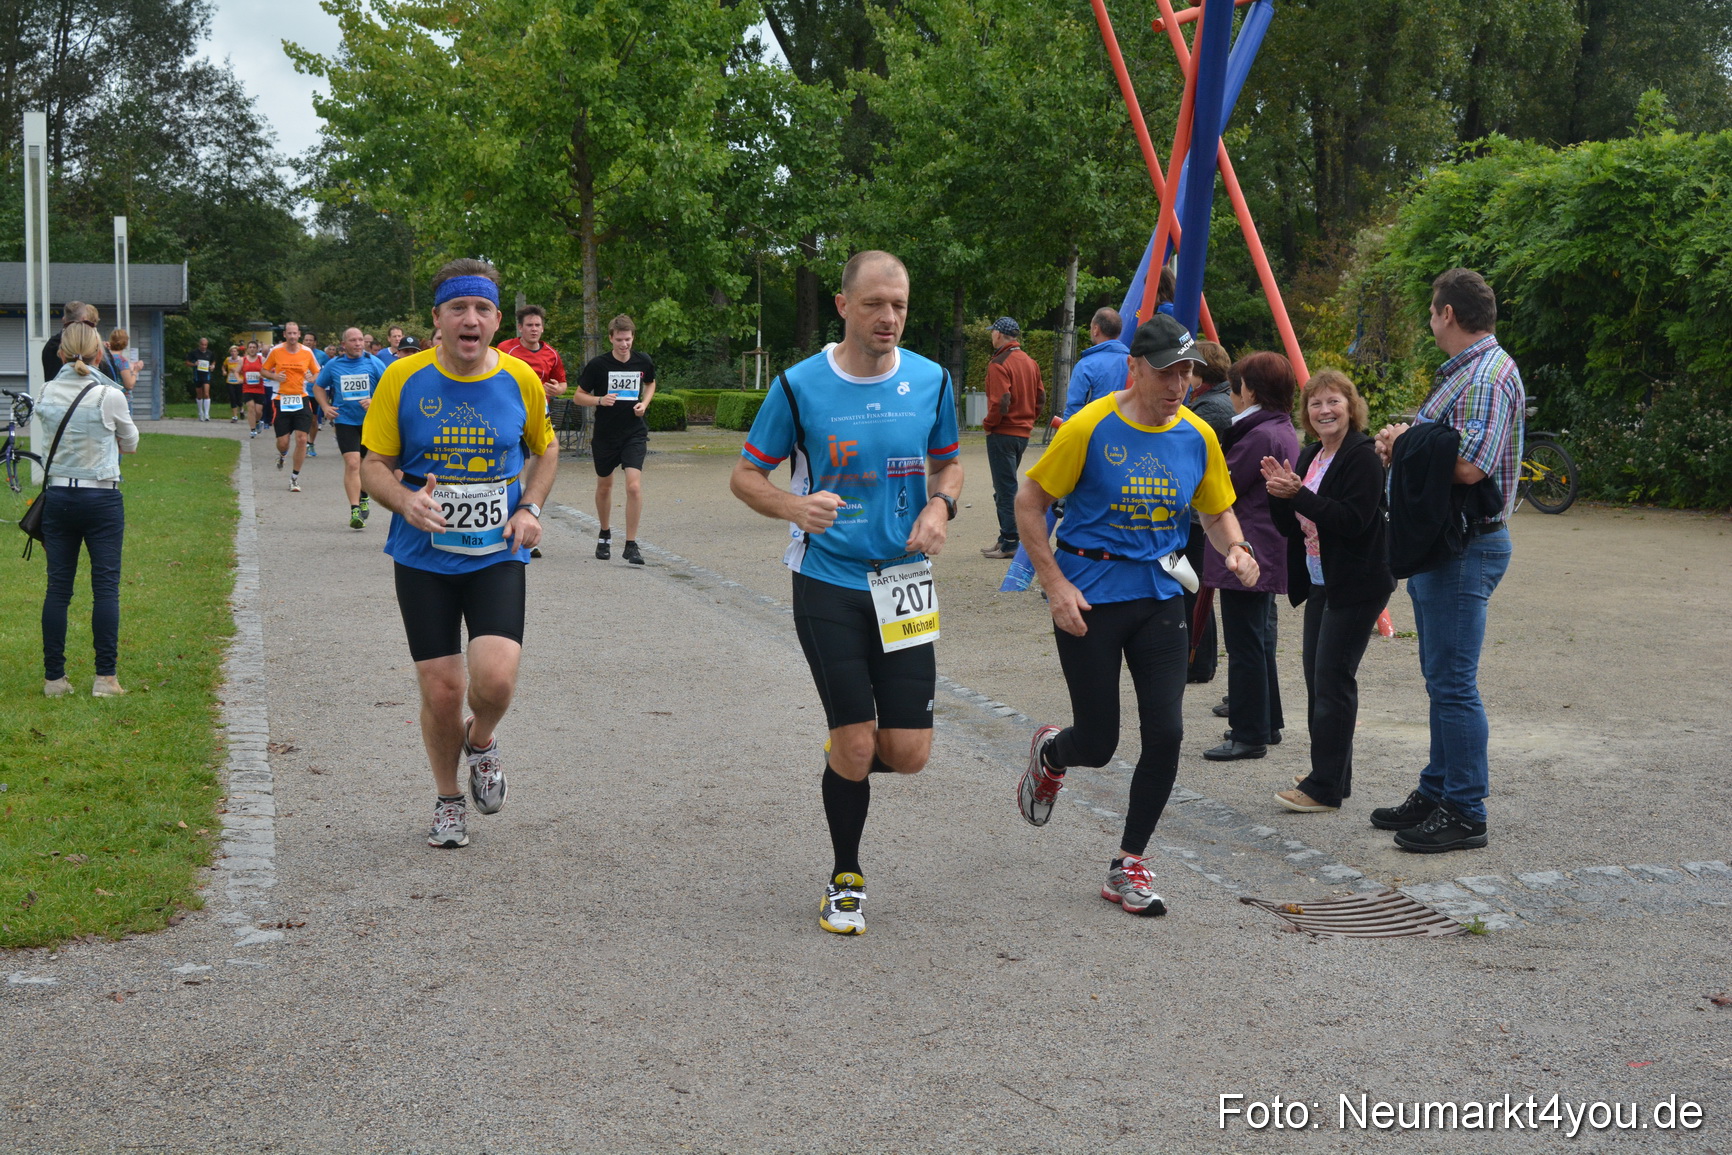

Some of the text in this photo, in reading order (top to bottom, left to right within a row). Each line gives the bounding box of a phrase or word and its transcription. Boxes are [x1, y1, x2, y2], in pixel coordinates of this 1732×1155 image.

[343, 380, 367, 391] 2290
[612, 378, 636, 390] 3421
[283, 396, 301, 405] 2770
[433, 489, 497, 500] PARTL Neumarkt
[440, 499, 503, 529] 2235
[461, 534, 484, 546] Max
[871, 569, 931, 588] PARTL Neumark
[892, 580, 933, 616] 207
[902, 617, 935, 636] Michael
